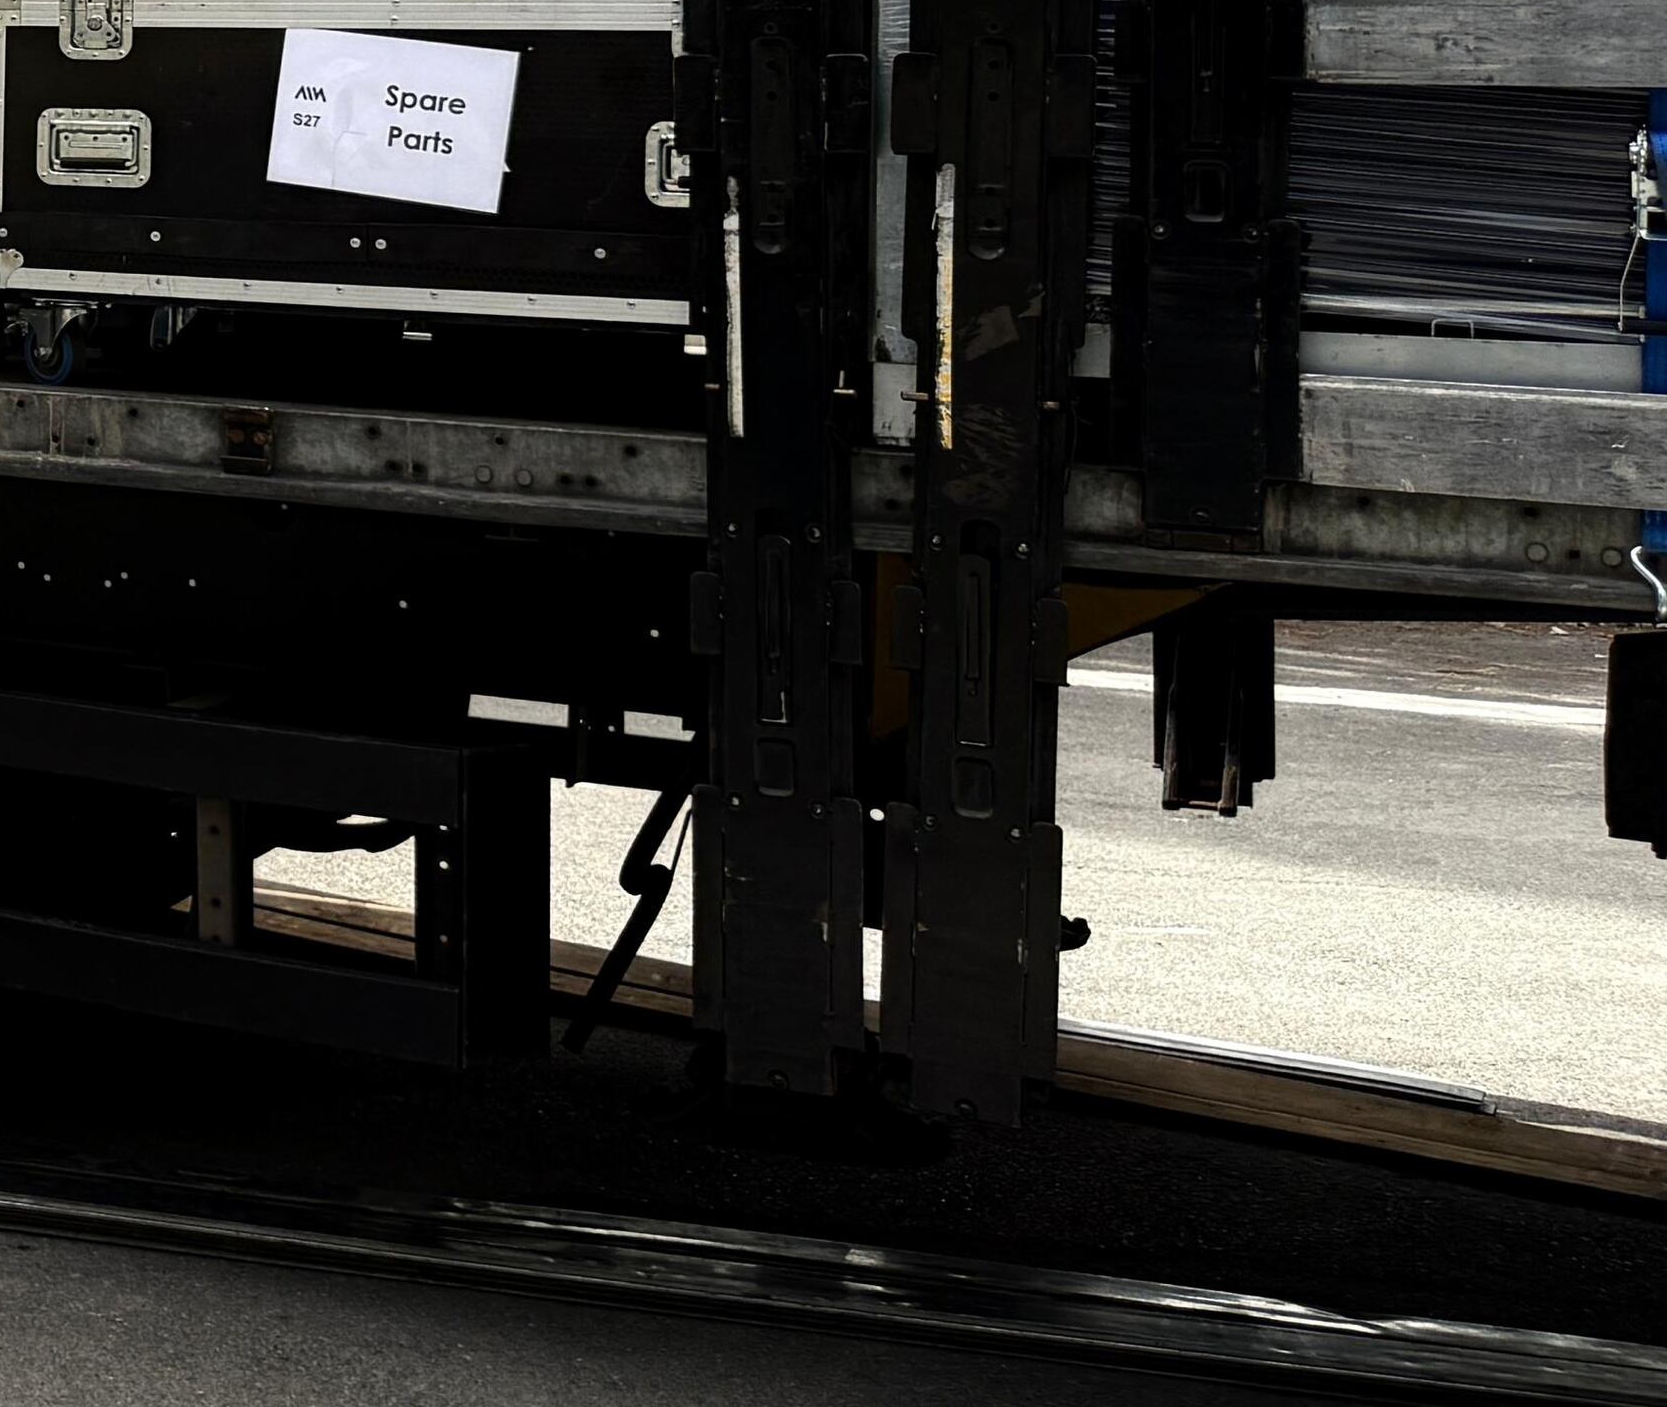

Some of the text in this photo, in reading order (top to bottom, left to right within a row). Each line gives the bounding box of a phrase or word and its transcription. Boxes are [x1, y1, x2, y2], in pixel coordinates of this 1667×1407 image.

[385, 85, 466, 114] Spare
[293, 113, 321, 127] S27
[387, 126, 453, 154] Parts
